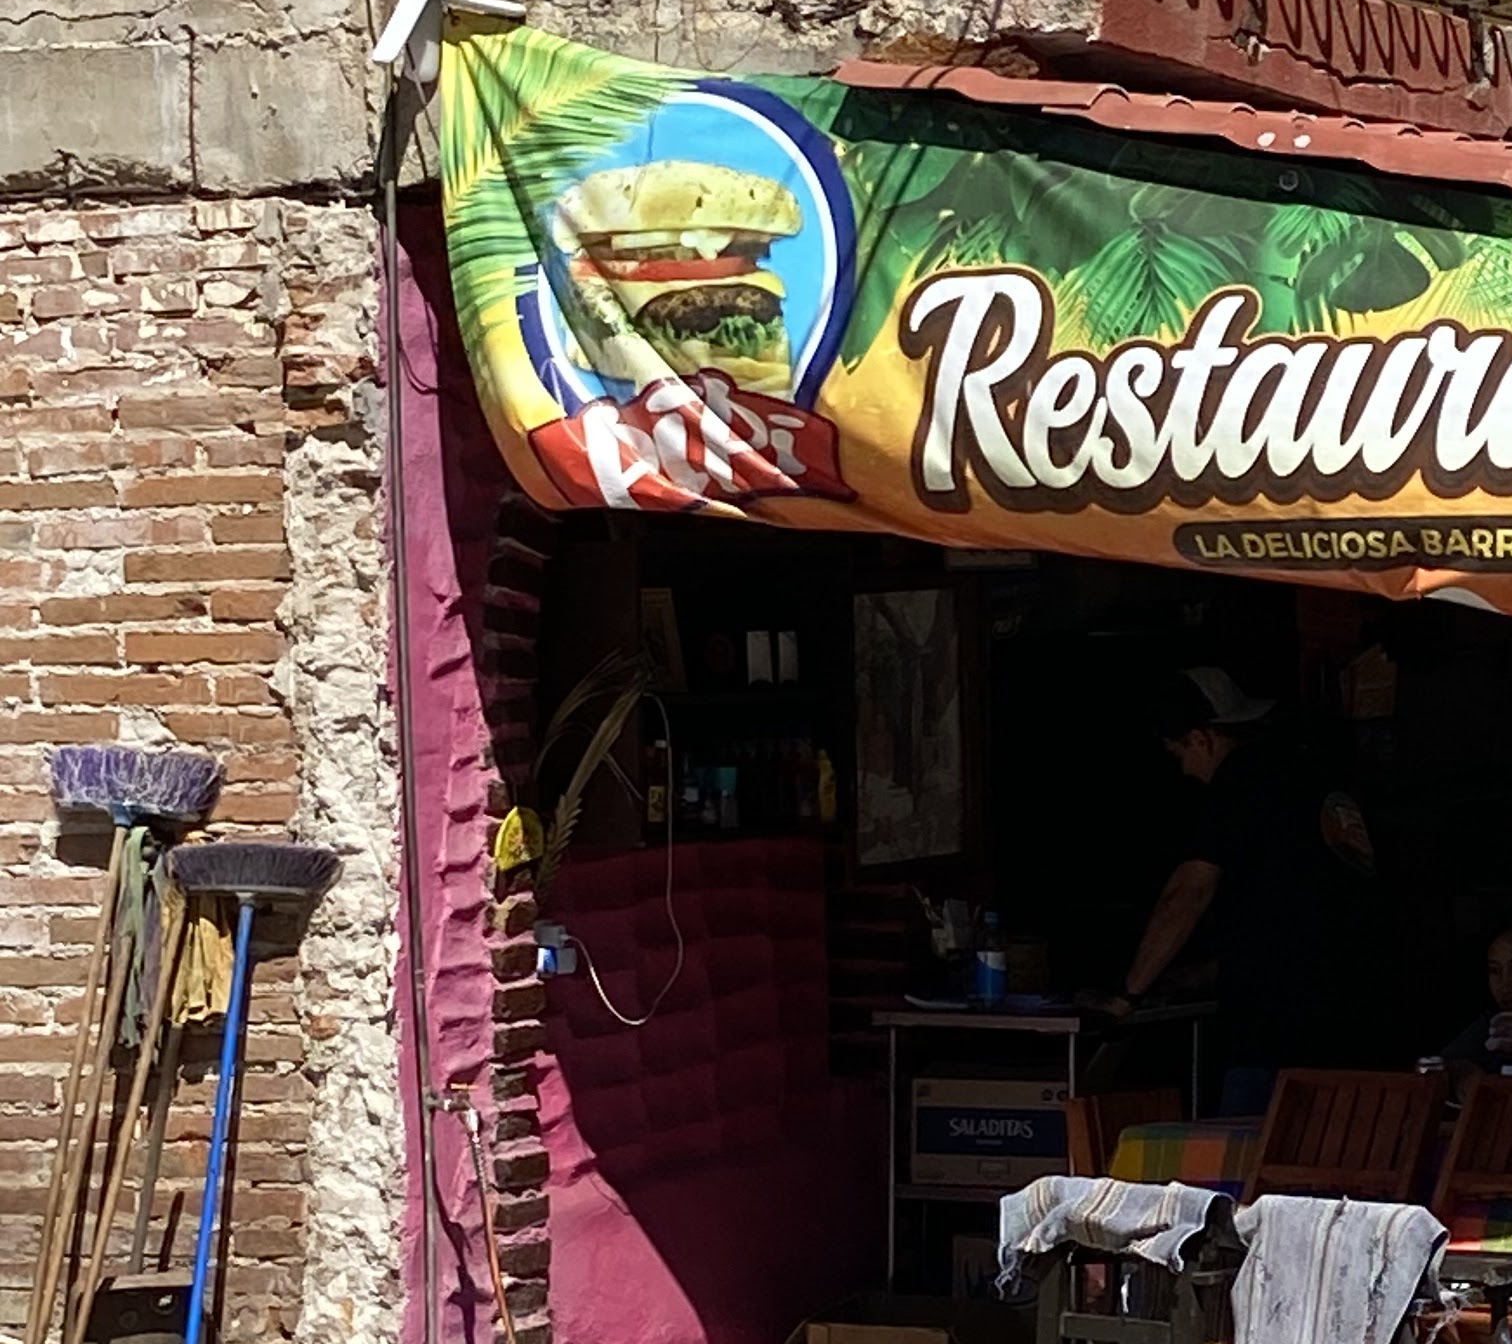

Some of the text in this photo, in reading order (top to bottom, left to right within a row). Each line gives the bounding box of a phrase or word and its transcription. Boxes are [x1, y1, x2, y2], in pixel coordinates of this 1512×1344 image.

[1195, 533, 1240, 558] LA
[1242, 529, 1416, 560] DELICIOSA
[949, 1117, 1034, 1139] SALADITAS
